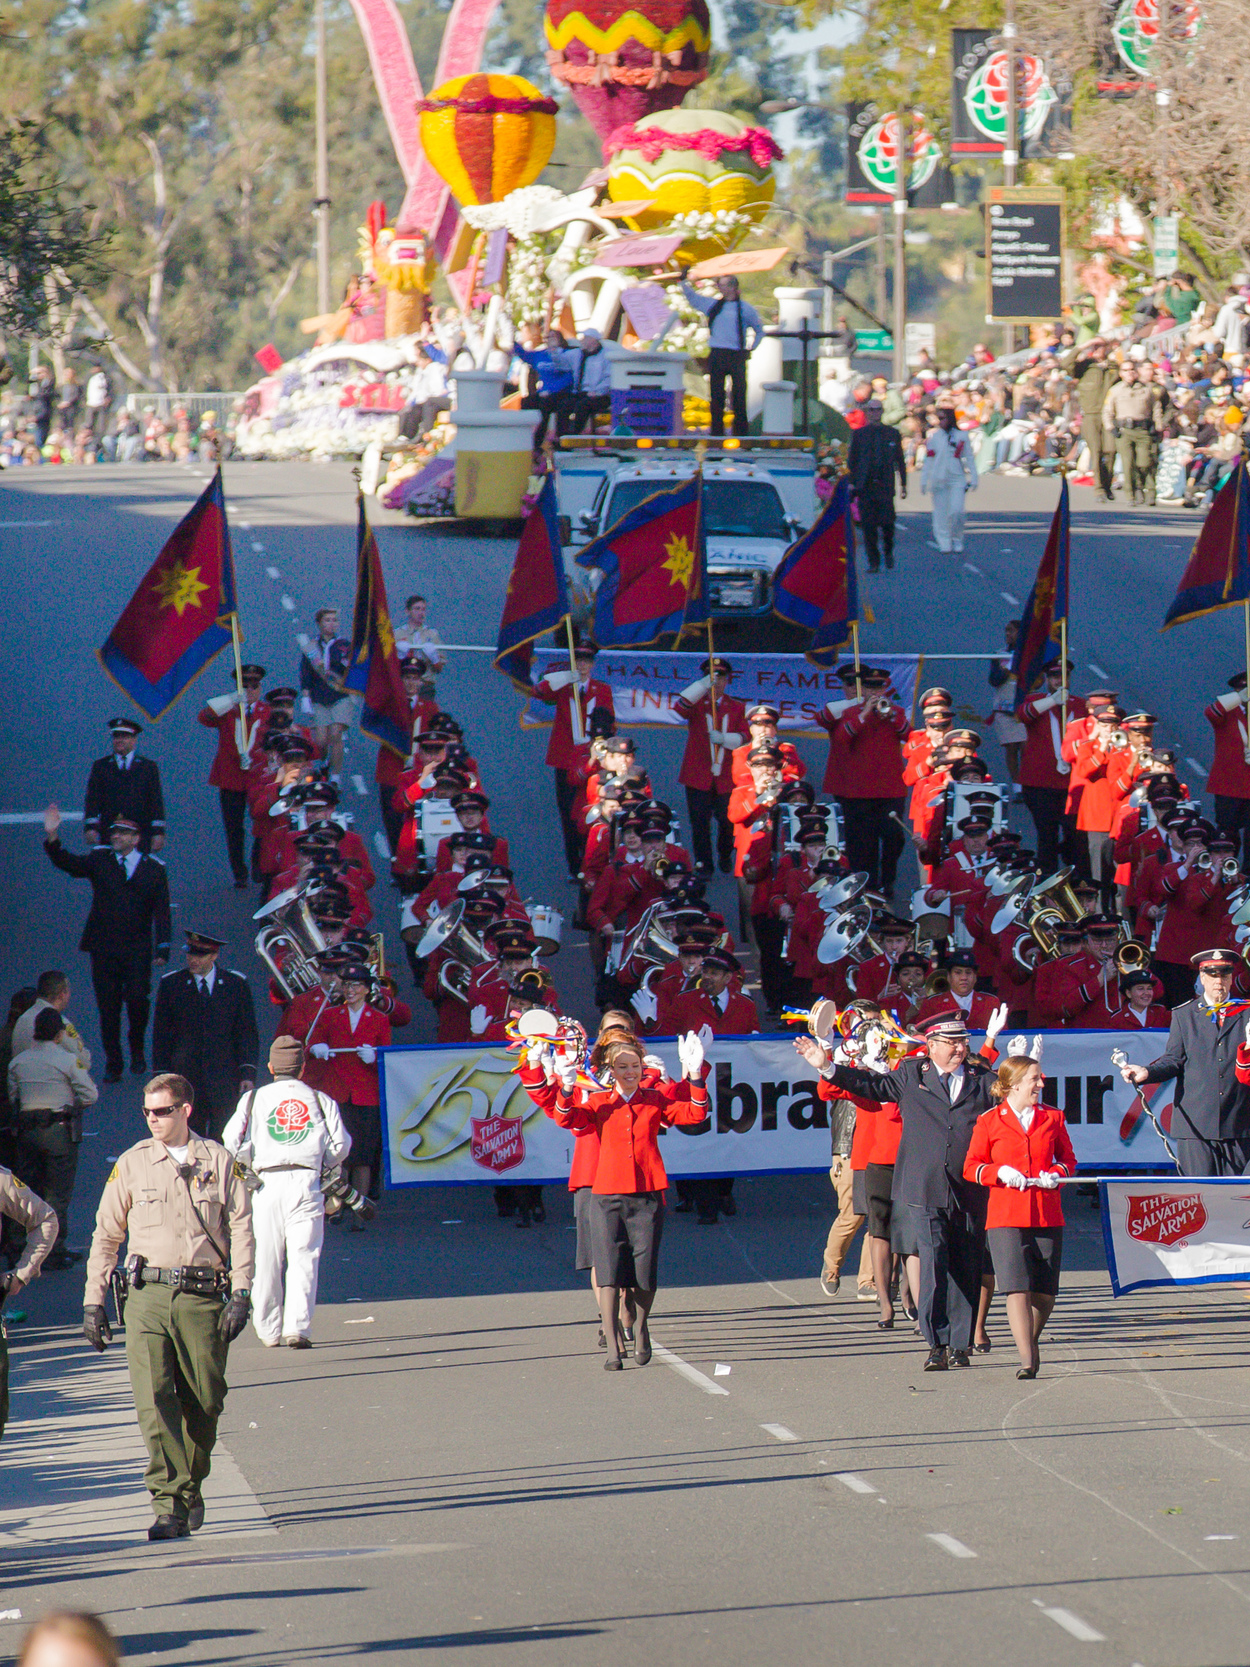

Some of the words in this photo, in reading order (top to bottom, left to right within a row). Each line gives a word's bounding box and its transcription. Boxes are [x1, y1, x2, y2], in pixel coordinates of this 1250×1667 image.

[614, 245, 657, 258] Love
[719, 256, 758, 269] Joy
[607, 665, 690, 680] HALL
[757, 671, 843, 690] FAME
[1042, 1075, 1114, 1124] ur
[475, 1122, 519, 1159] SALVATION
[480, 1120, 500, 1140] THE
[491, 1139, 518, 1167] ARMY
[1131, 1195, 1199, 1236] SALVATION
[1140, 1195, 1170, 1213] THE
[1158, 1207, 1198, 1241] ARMY
